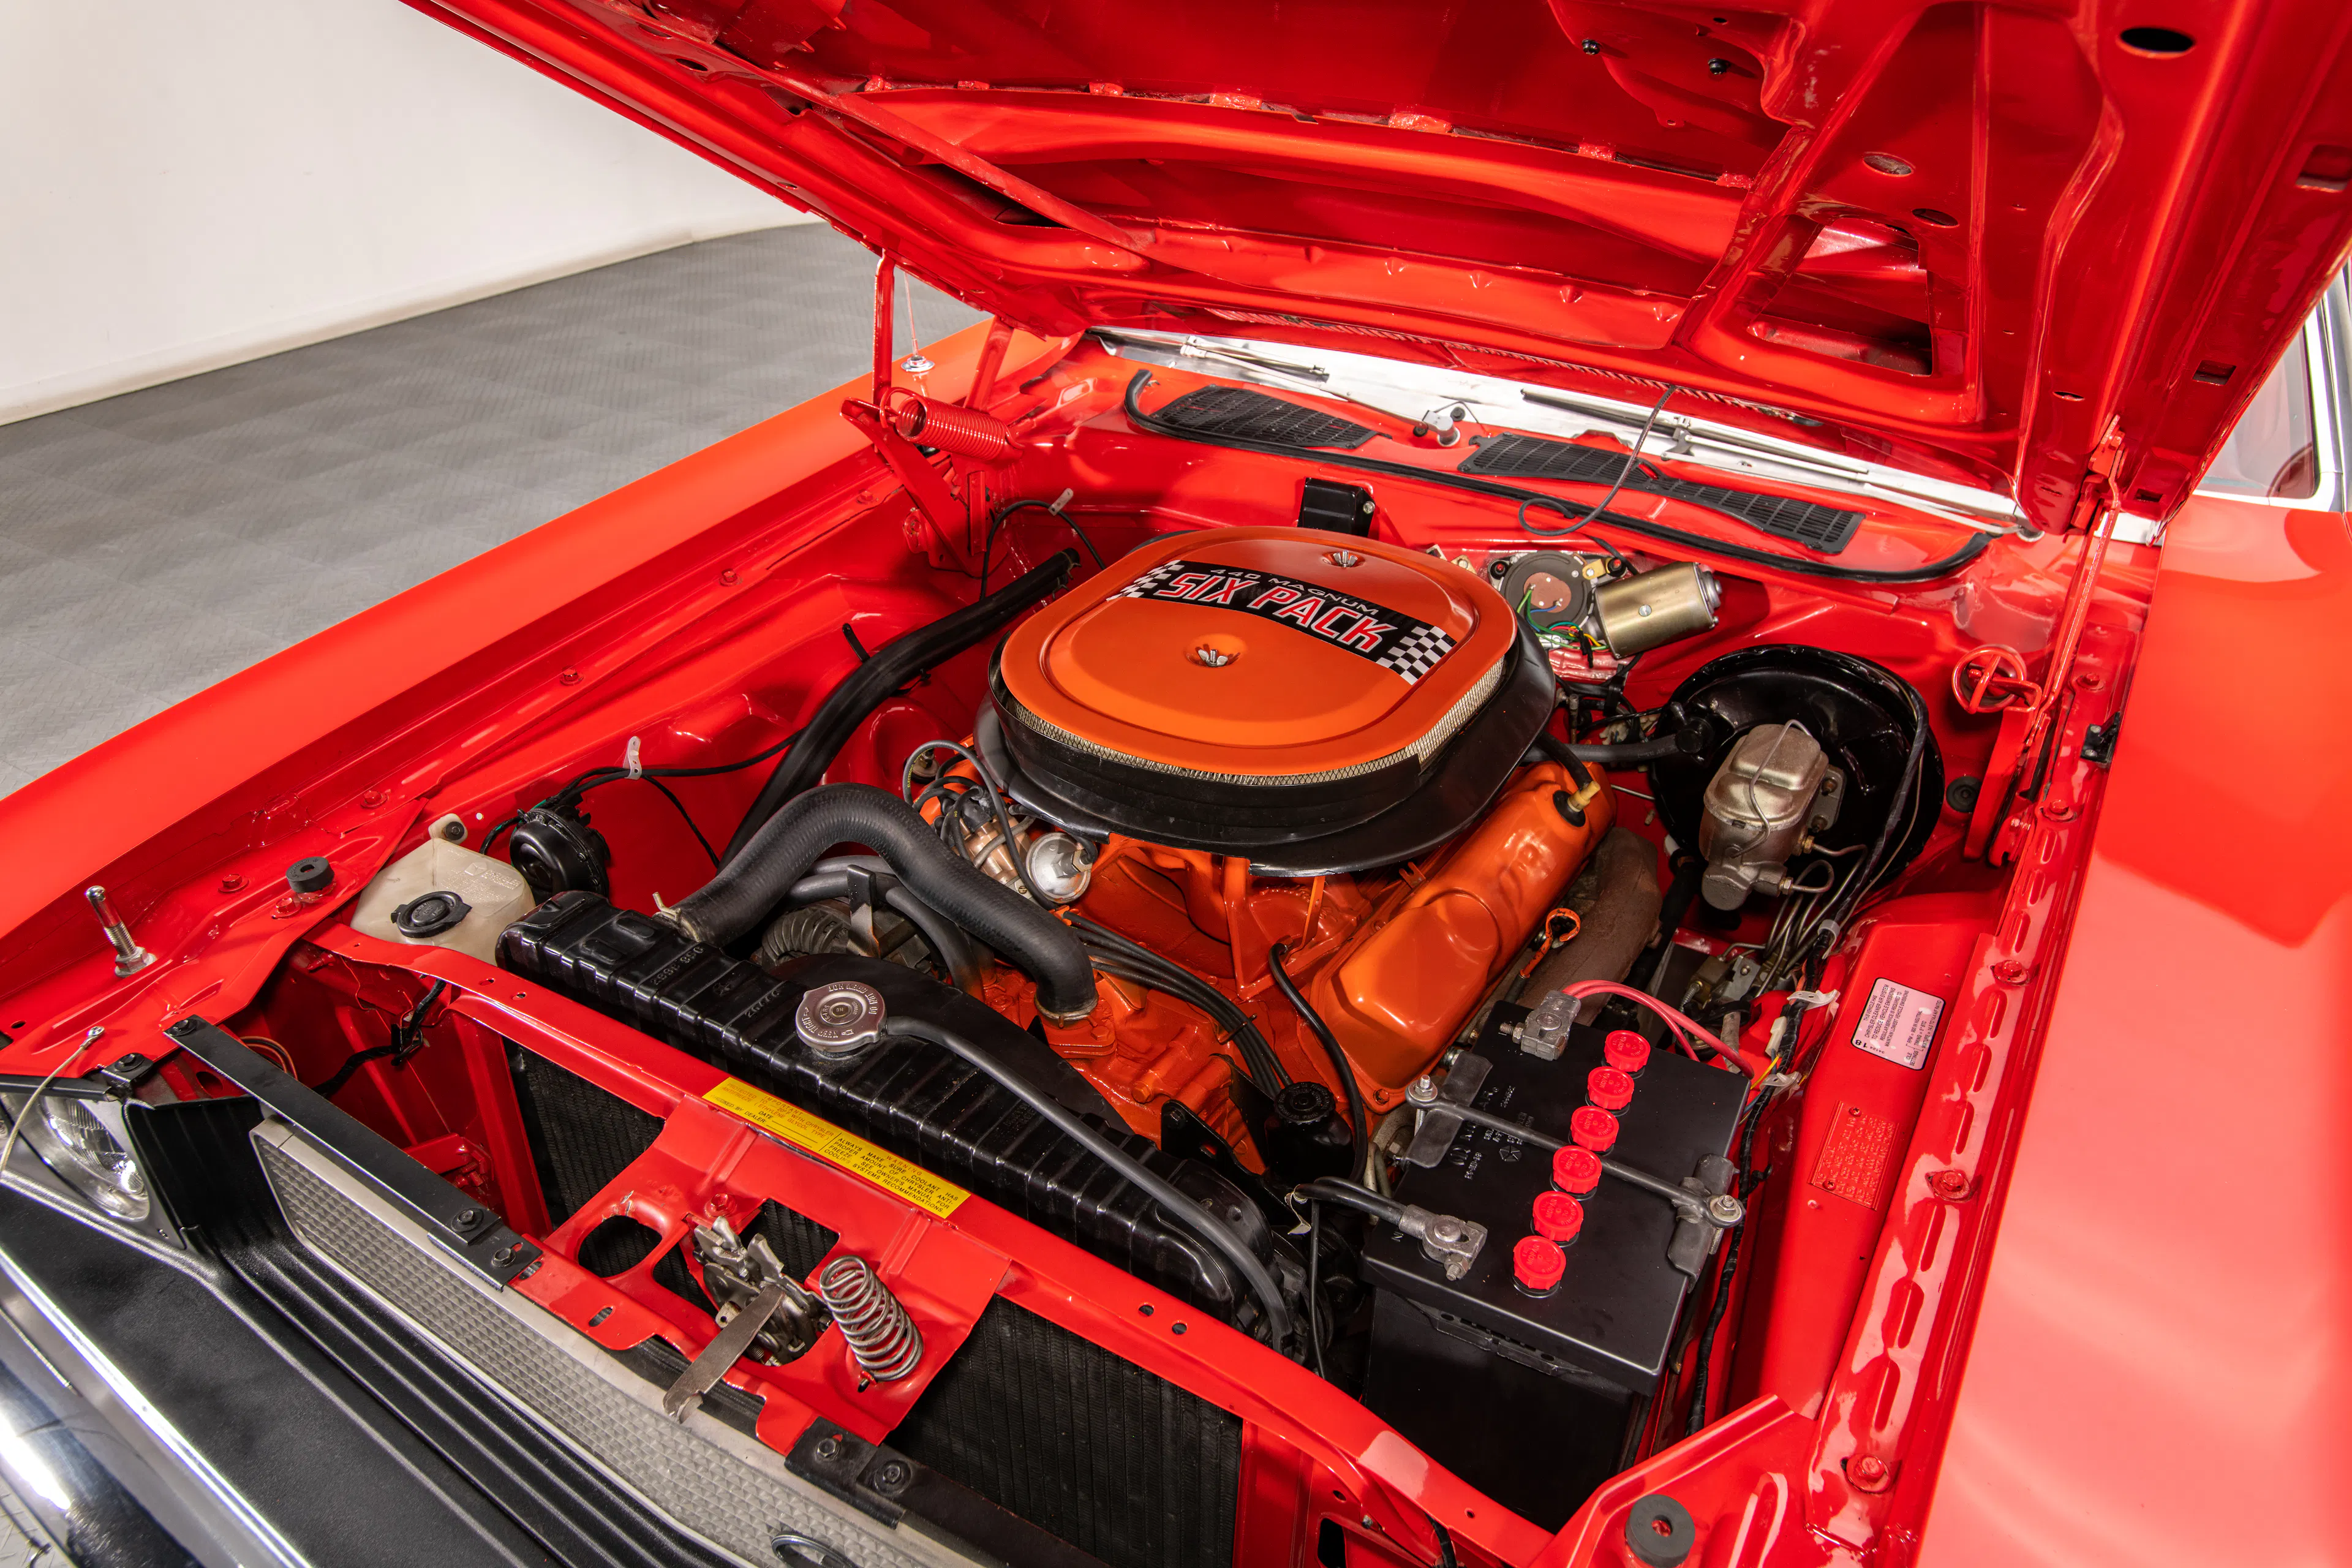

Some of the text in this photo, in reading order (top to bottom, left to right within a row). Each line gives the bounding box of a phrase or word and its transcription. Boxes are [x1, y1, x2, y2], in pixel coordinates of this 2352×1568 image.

[1210, 568, 1379, 615] 440 MAGNUM
[1153, 572, 1398, 654] SIX PACK
[1864, 1019, 1875, 1038] CHRYSLER
[1871, 1003, 1882, 1019] CLEANER
[1880, 984, 1889, 997] SYSTEM
[1874, 1019, 1883, 1035] REDUCE
[1879, 1005, 1888, 1020] VEHICLE
[1884, 987, 1895, 1006] EMISSIONS
[1880, 1026, 1888, 1041] REGULAR
[1885, 1013, 1893, 1027] SERVICE
[1891, 995, 1900, 1011] REQUIRED
[1885, 1031, 1893, 1047] MAINTAIN
[1899, 990, 1909, 1006] EMISSIONS
[1913, 1009, 1922, 1023] NEUTRAL
[1909, 1050, 1918, 1066] SETTINGS
[1921, 1034, 1929, 1048] MIXTURE
[726, 1082, 758, 1099] PROTECTED
[790, 1114, 807, 1123] WITH
[804, 1121, 834, 1136] CHRYSLER
[758, 1110, 773, 1120] DATE
[763, 1095, 802, 1115] IMPORTANT
[786, 1118, 809, 1130] GLYCOL
[832, 1141, 858, 1155] PROPER
[859, 1155, 887, 1170] AMOUNT
[900, 1175, 935, 1194] CHRYSLER
[837, 1137, 959, 1200] ALWAYS MAKE SURE COOLANT HAS
[851, 1163, 881, 1180] SYSTEMS
[885, 1156, 923, 1175] WARNING
[875, 1169, 905, 1185] OWNER'S
[907, 1185, 934, 1200] MANUAL
[935, 1200, 950, 1208] FOR
